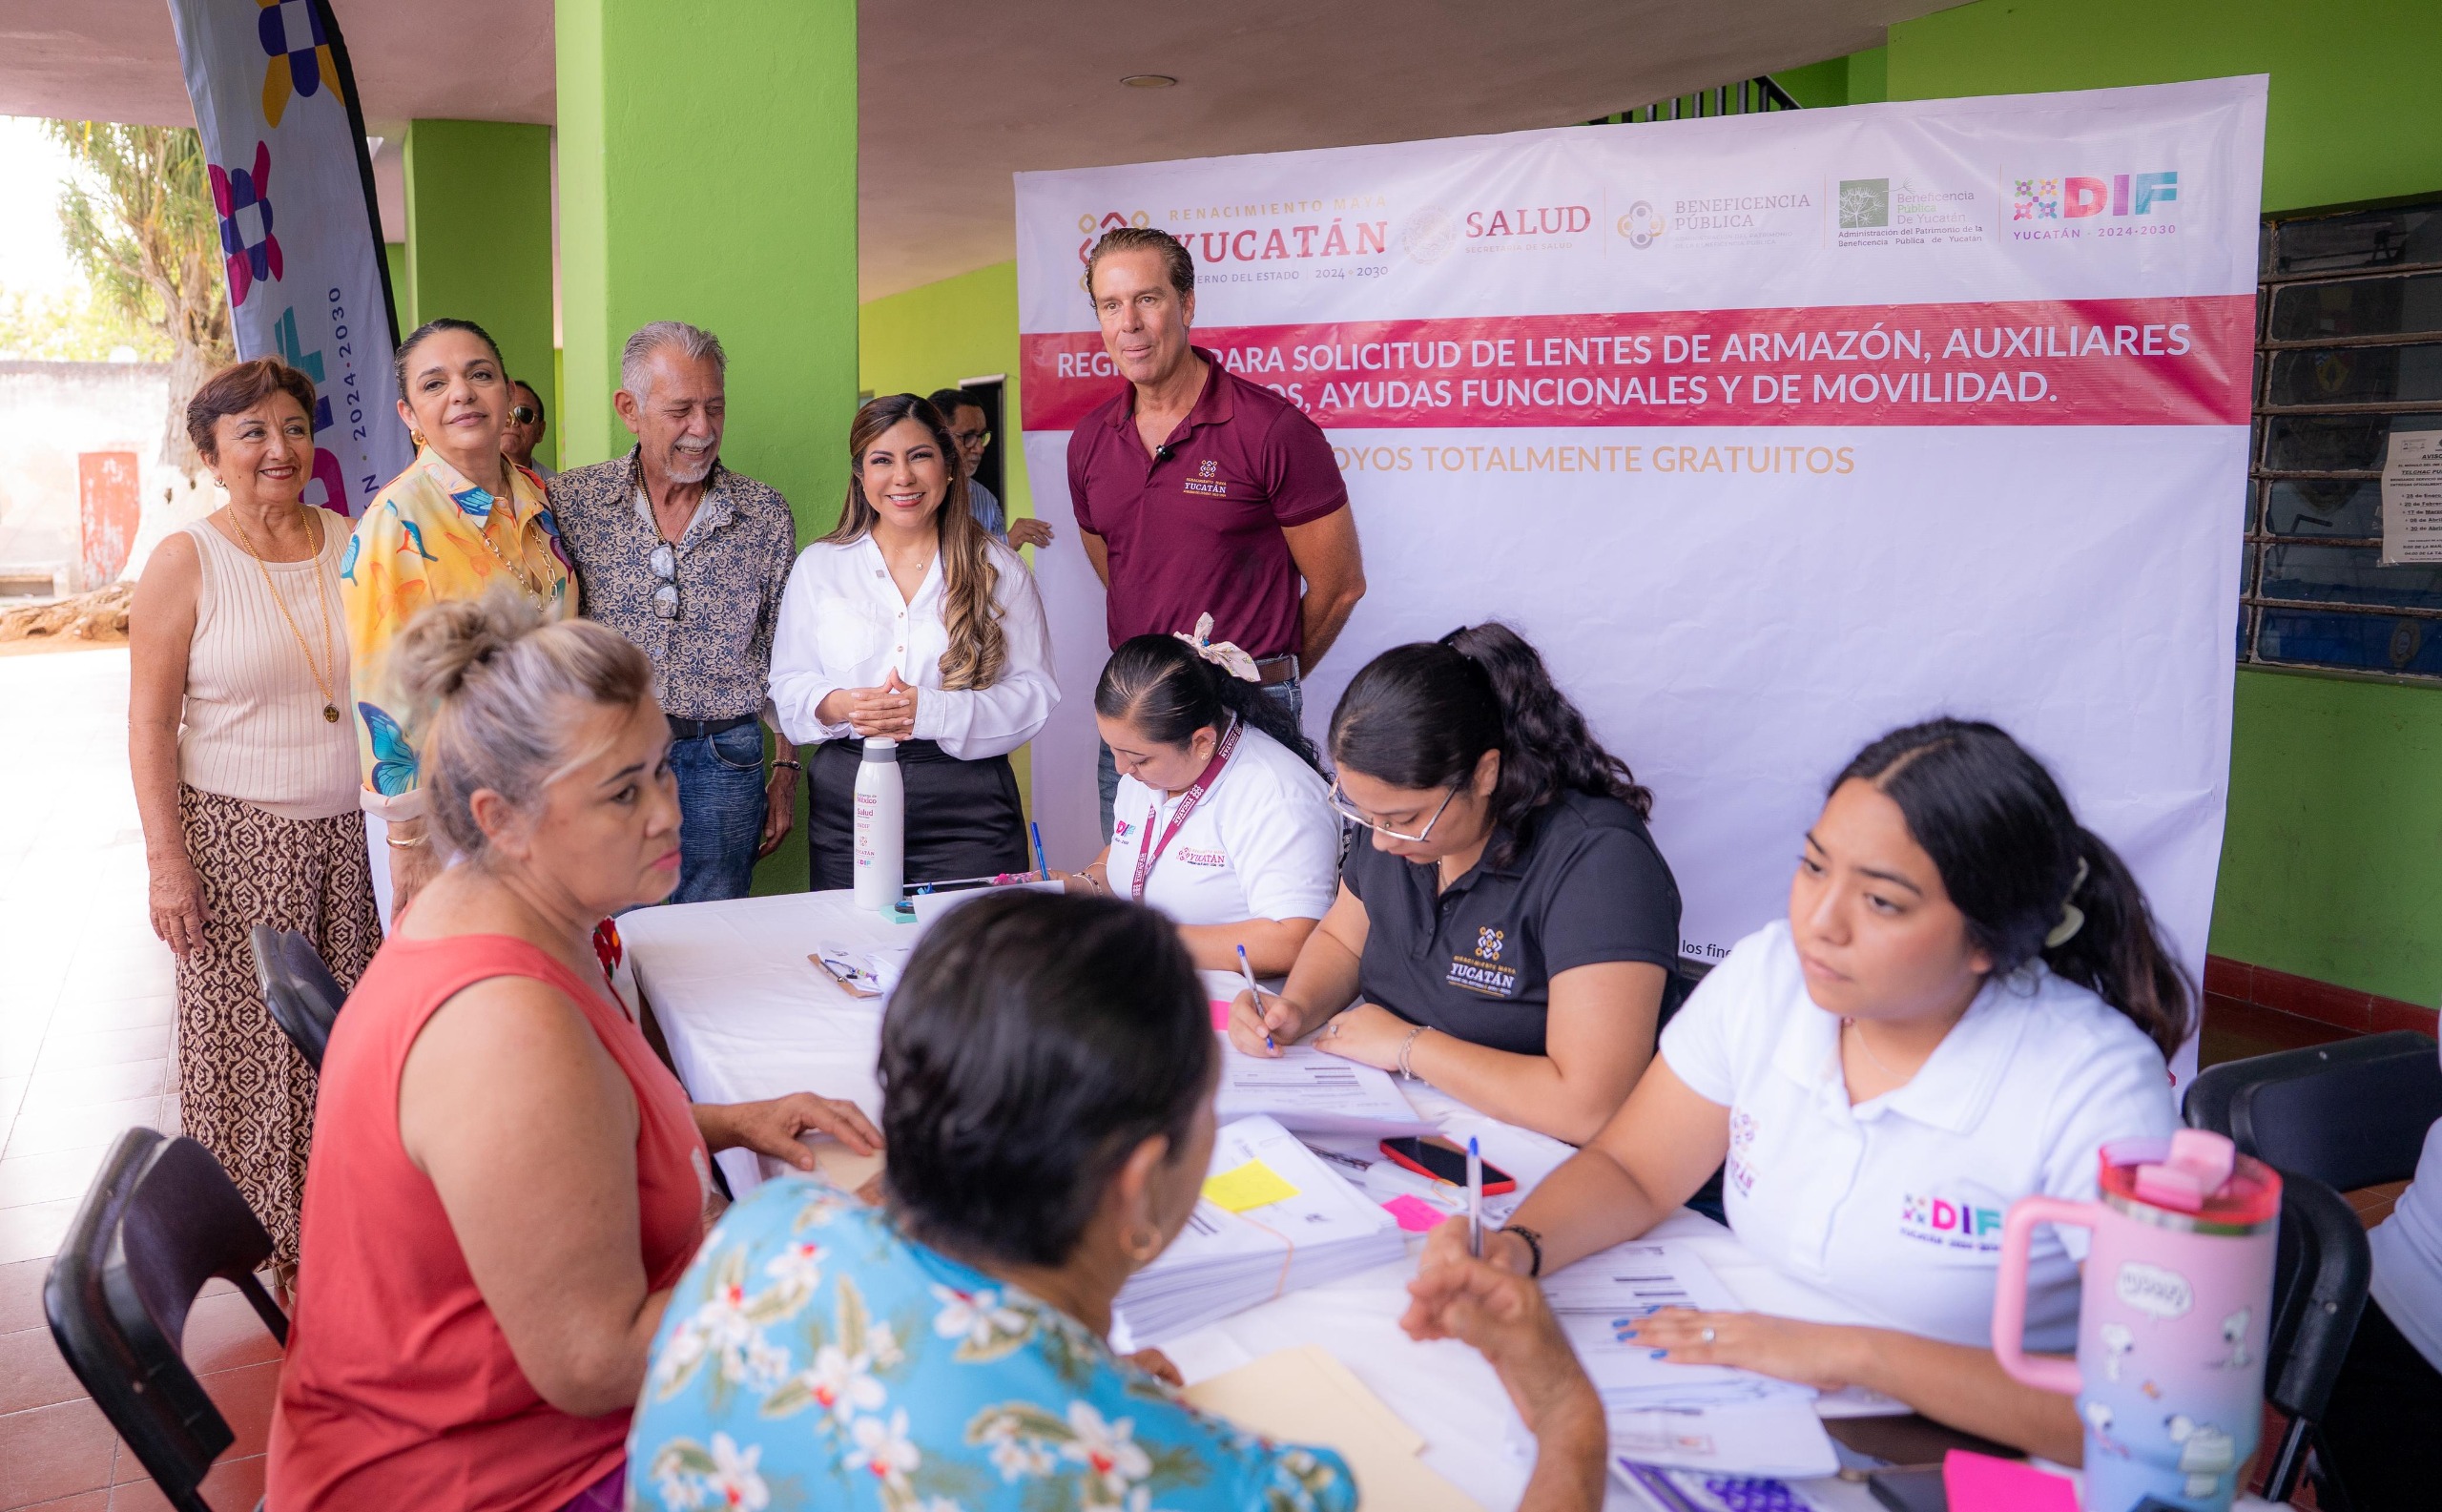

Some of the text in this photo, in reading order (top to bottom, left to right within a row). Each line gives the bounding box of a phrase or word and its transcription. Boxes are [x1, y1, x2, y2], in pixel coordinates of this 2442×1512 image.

[1897, 191, 1975, 203] Beneficencia
[2064, 172, 2178, 218] DIF
[1169, 195, 1387, 221] RENACIMIENTO MAYA
[1675, 195, 1811, 214] BENEFICENCIA
[1897, 204, 1936, 214] Pública
[1465, 205, 1591, 238] SALUD
[1675, 214, 1754, 230] PÚBLICA
[1897, 213, 1966, 224] De Yucatán
[1838, 229, 1898, 238] Administración
[1915, 226, 1960, 235] Patrimonio
[2014, 228, 2080, 240] YUCATÁN
[1838, 238, 1888, 247] Beneficencia
[1197, 266, 1389, 284] ERNO DEL ESTADO 2024 2030
[1293, 341, 1461, 372] SOLICITUD
[1472, 339, 1515, 367] DE
[1526, 335, 1652, 365] LENTES
[1663, 334, 1710, 363] DE
[1720, 322, 1933, 364] ARMAZÓN,
[1941, 323, 2191, 359] AUXILIARES
[1319, 380, 1452, 409] AYUDAS
[1462, 376, 1707, 407] FUNCIONALES
[1717, 375, 1742, 404] Y
[1753, 374, 1801, 404] DE
[1813, 371, 2059, 404] MOVILIDAD.
[1333, 445, 1854, 474] OYOS TOTALMENTE GRATUITOS
[1185, 483, 1227, 493] YUCATÁN
[1682, 940, 1702, 954] los
[1450, 963, 1515, 988] YUCATÁN
[1932, 1198, 2000, 1236] DIF
